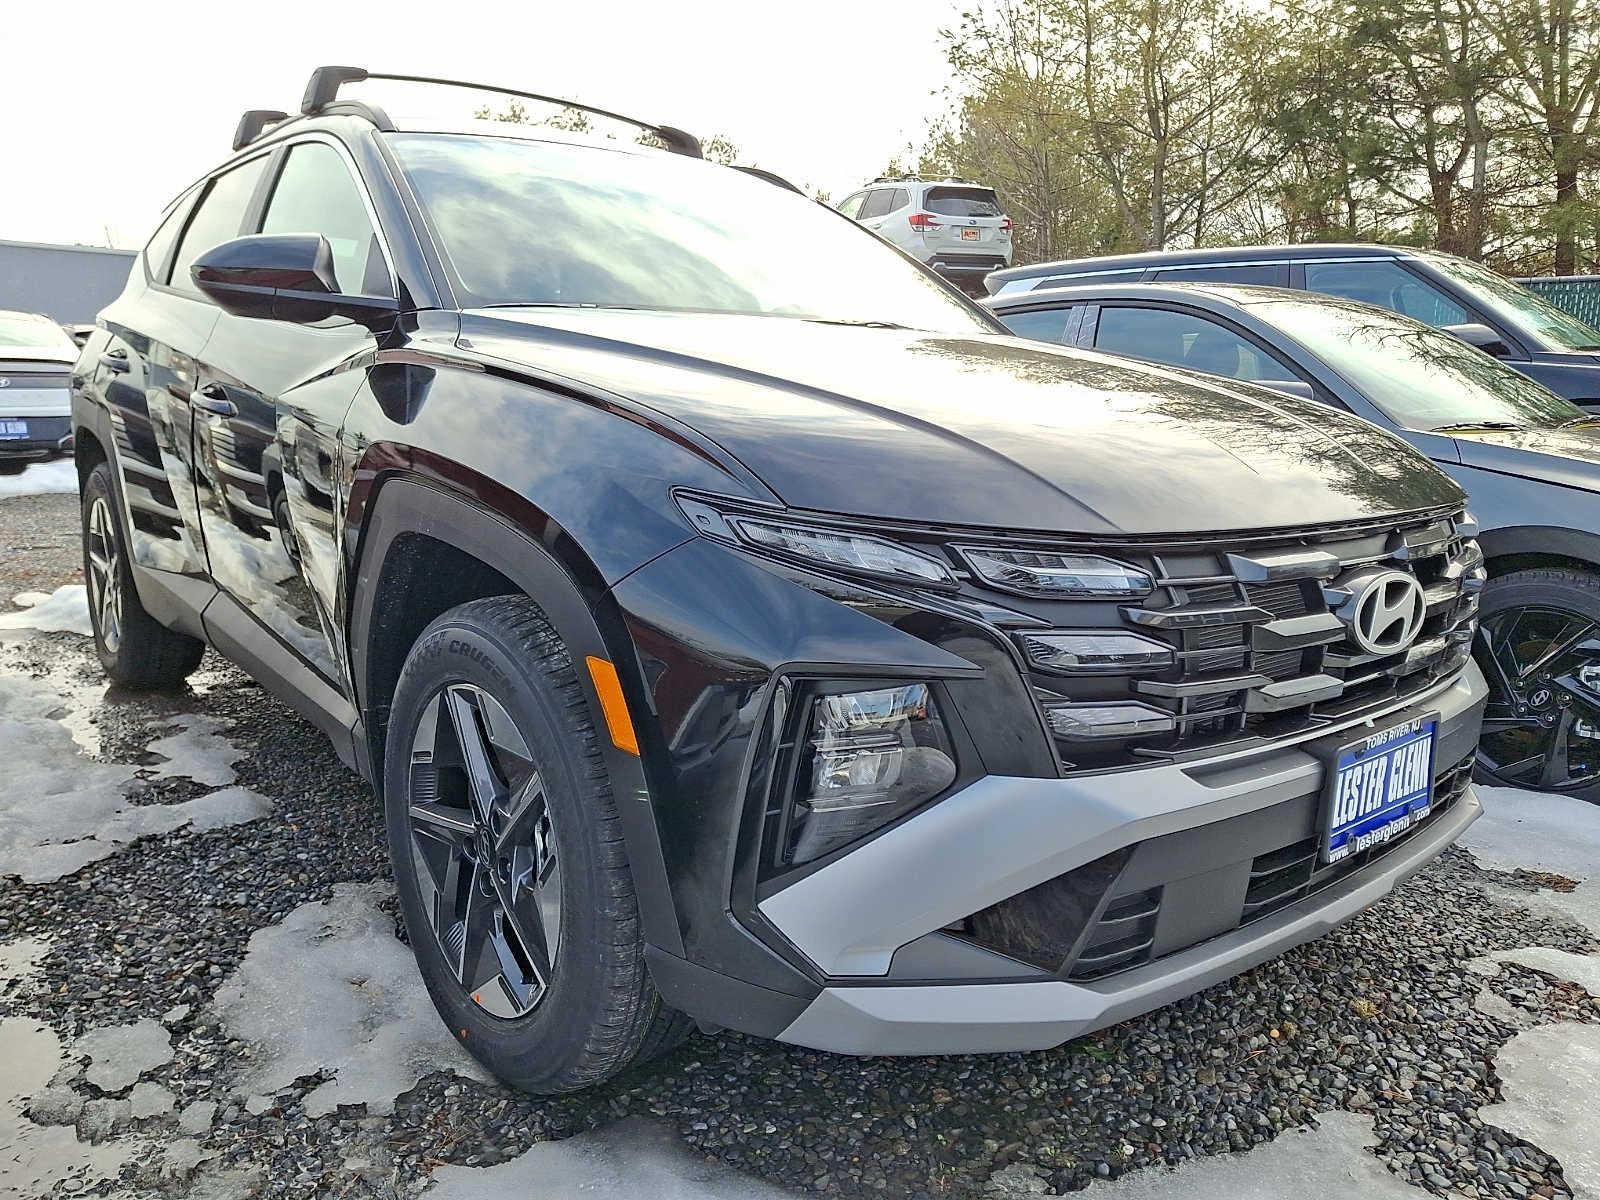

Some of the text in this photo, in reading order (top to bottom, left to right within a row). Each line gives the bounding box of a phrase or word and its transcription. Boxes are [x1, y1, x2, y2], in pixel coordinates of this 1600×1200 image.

[1366, 733, 1388, 750] TOMS
[1411, 719, 1421, 732] NJ
[1332, 736, 1431, 828] LESTER GLENN
